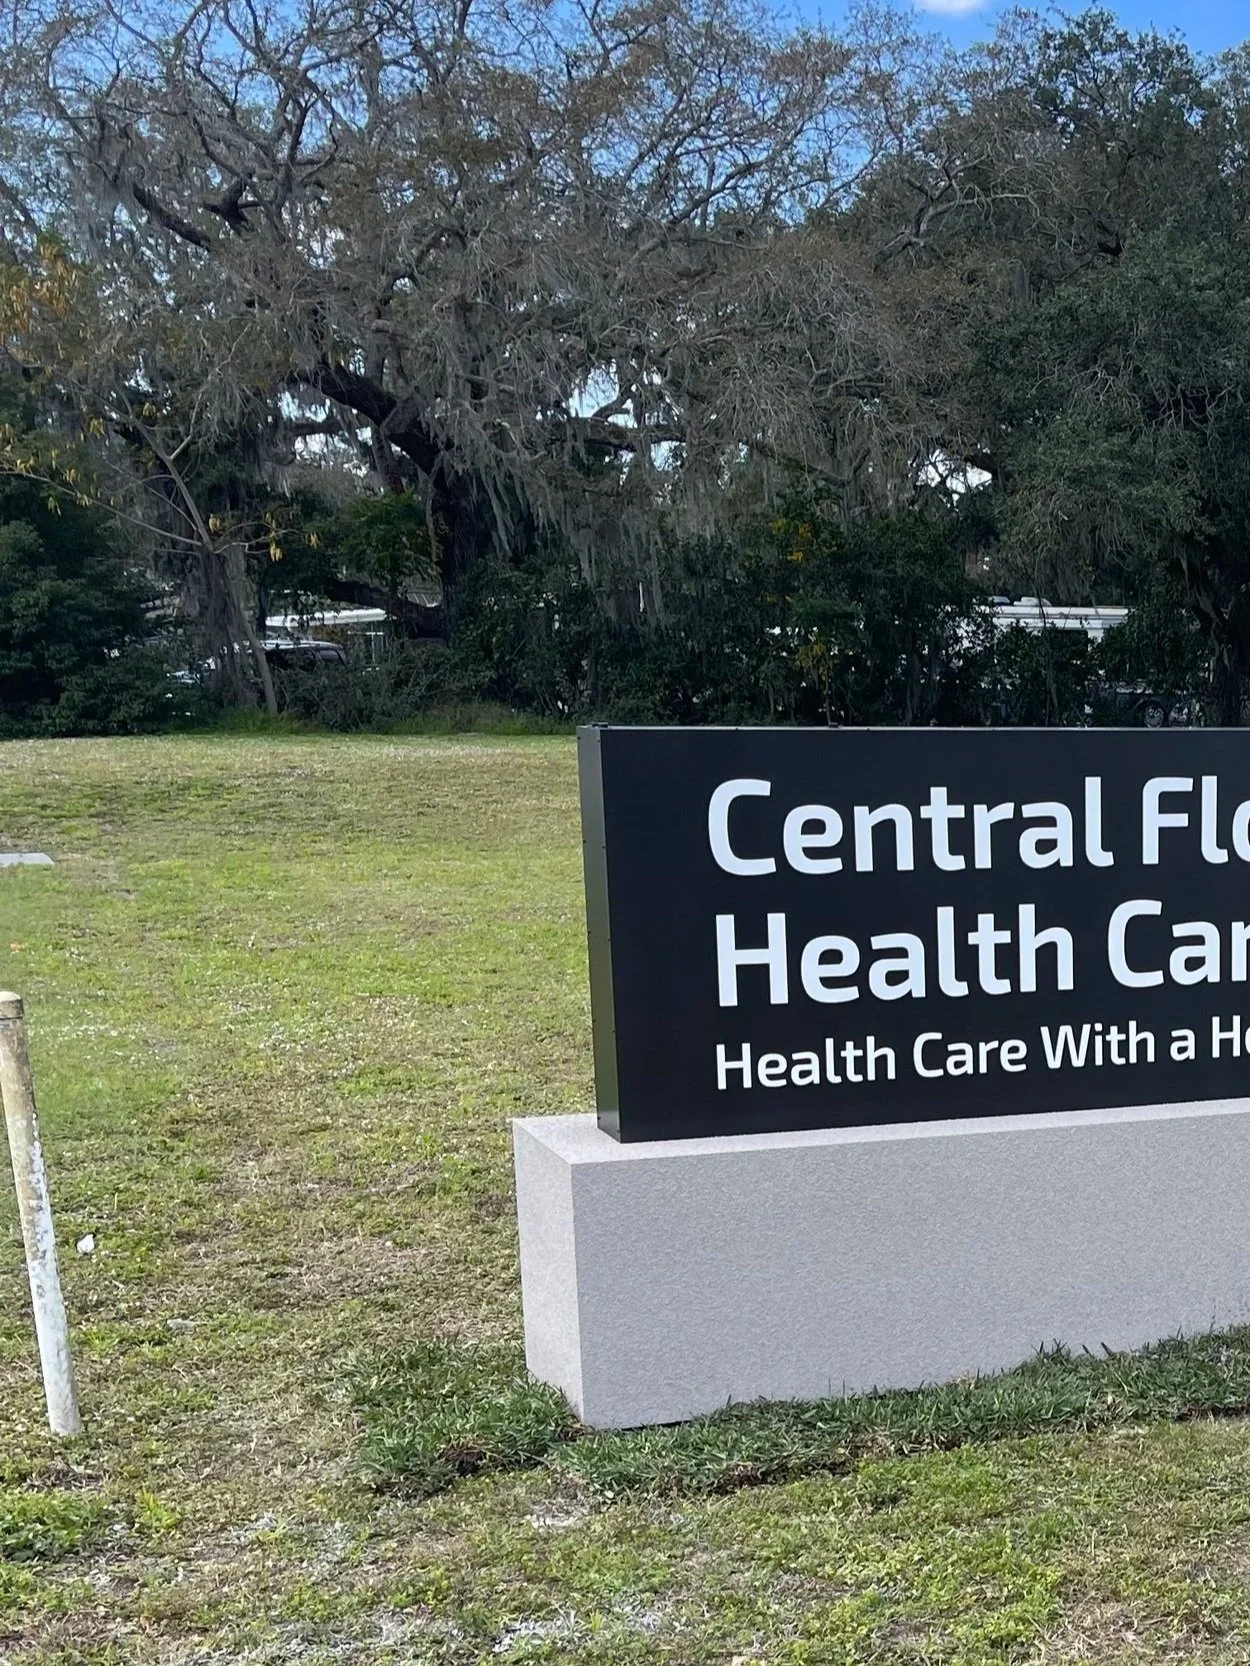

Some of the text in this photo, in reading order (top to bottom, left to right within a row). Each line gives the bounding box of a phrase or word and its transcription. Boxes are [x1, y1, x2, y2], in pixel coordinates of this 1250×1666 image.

[708, 776, 1115, 876] Central
[715, 903, 1074, 1007] Health
[716, 1035, 897, 1090] Health
[913, 1031, 1028, 1078] Care
[1040, 1020, 1155, 1069] With
[1170, 1028, 1196, 1061] a
